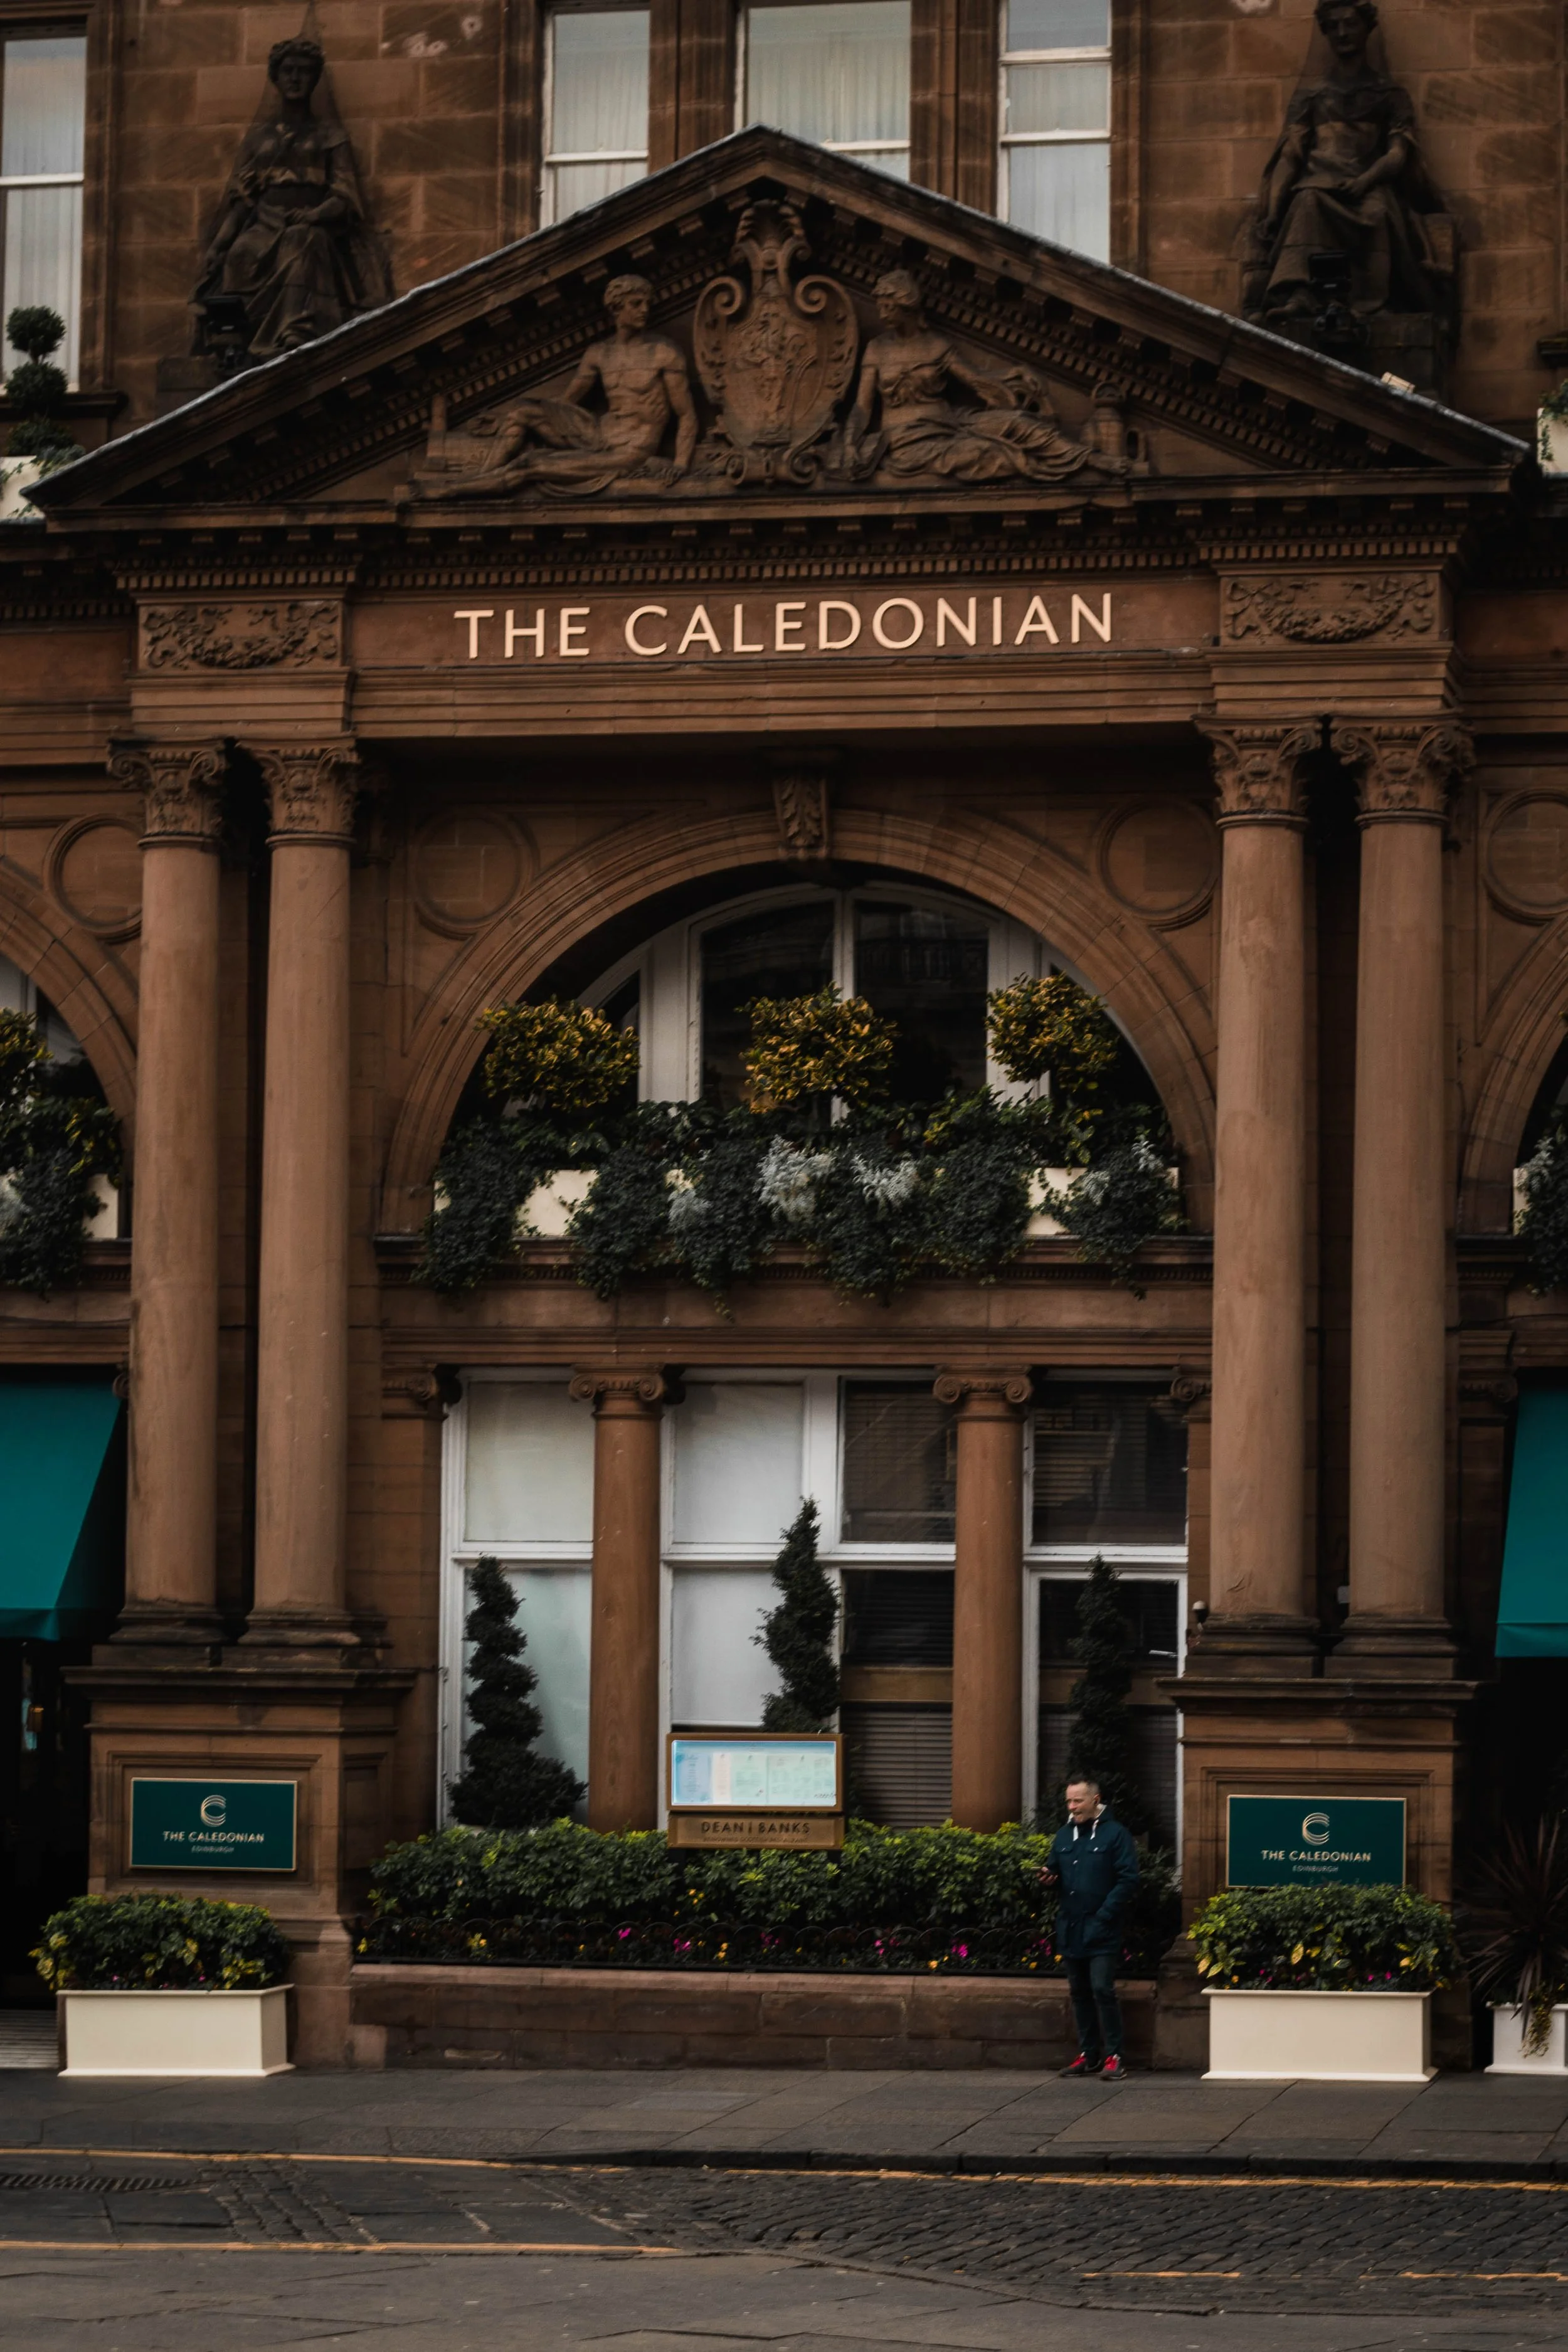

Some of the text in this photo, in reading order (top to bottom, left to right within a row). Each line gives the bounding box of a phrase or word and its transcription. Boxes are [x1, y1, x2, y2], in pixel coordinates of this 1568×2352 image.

[453, 592, 1112, 659] THE CALEDONIAN
[701, 1821, 744, 1834] DEAN
[758, 1822, 810, 1835] BANKS
[162, 1831, 265, 1844] THE CALEDONIAN
[191, 1845, 235, 1853] EDINBURGH
[1261, 1850, 1371, 1862] THE CALEDONIAN
